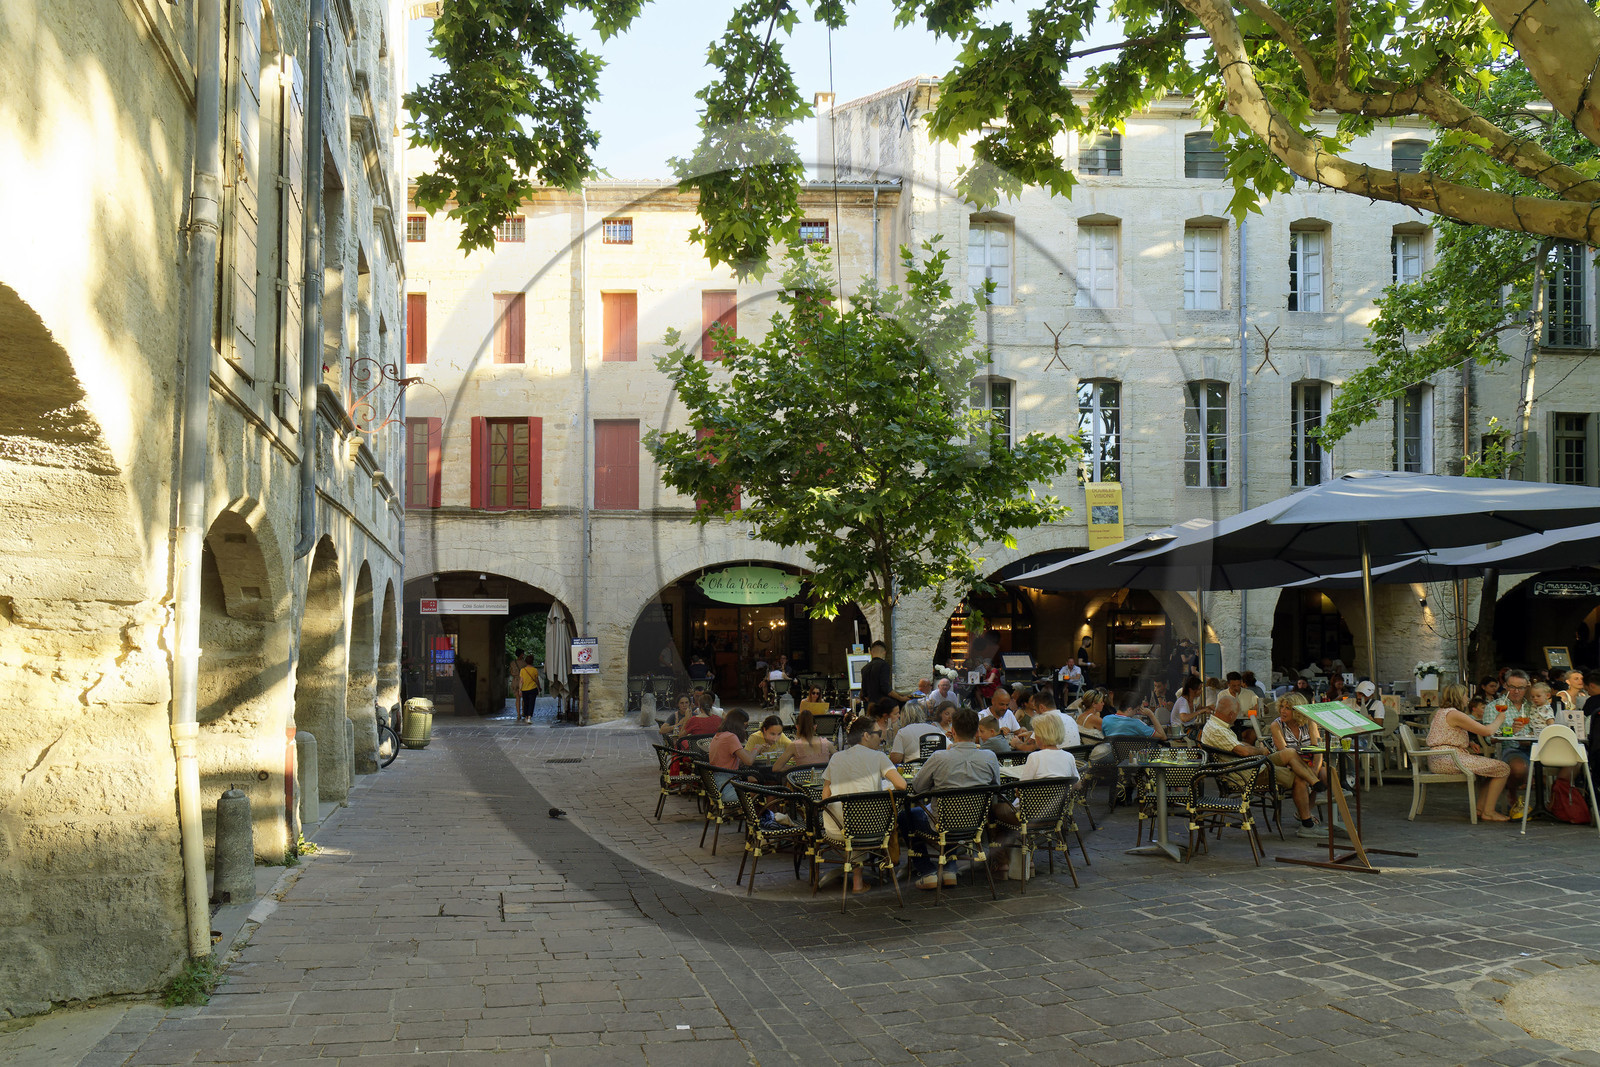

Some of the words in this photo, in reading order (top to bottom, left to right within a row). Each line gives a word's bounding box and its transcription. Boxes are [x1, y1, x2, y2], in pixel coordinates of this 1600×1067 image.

[708, 578, 723, 589] Oh
[726, 578, 736, 589] la
[739, 578, 769, 589] Vache
